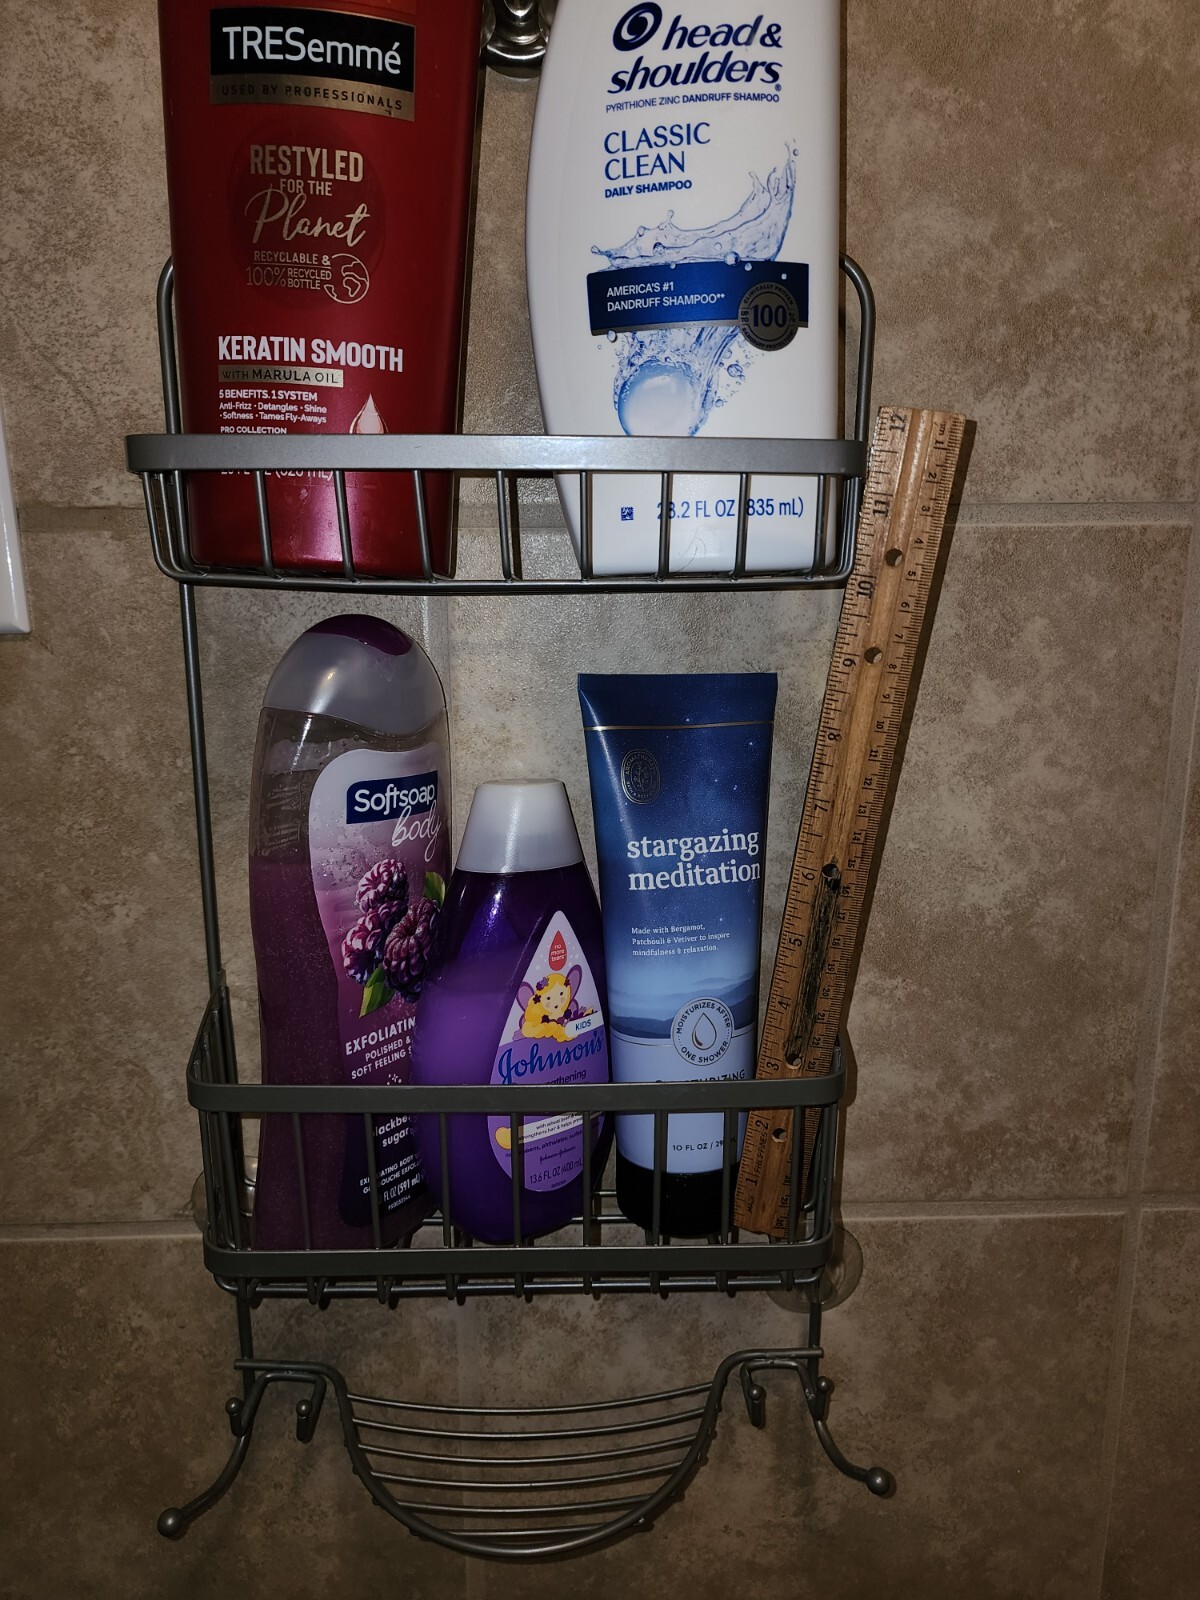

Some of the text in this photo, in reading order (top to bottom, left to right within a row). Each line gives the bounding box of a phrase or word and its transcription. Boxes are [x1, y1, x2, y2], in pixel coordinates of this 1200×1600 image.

[662, 14, 783, 50] head &
[222, 26, 401, 75] TRESemmé
[222, 84, 403, 111] USED BY PROFESSIONALS
[605, 92, 780, 113] PYRITHIONE ZINC DANDRUFF SHAMPOO
[604, 122, 711, 154] CLASSIC
[250, 144, 364, 182] RESTYLED
[604, 151, 685, 181] CLEAN
[280, 179, 333, 196] FOR THE
[604, 179, 693, 198] DAILY SHAMPOO
[245, 184, 371, 248] Planet
[254, 250, 332, 266] RECYCLABLE &
[246, 266, 333, 287] 100% RECYCLED
[287, 278, 321, 290] BOTTLE
[606, 281, 675, 298] AMERICA'S #1
[607, 298, 661, 312] DANDRUFF
[750, 304, 787, 328] 100
[218, 336, 404, 372] KERATIN SMOOTH
[222, 368, 339, 384] WITH MARULA OIL
[219, 389, 318, 401] 5 BENEFITS. 1 SYSTEM
[219, 401, 328, 414] Anti-Frizz Detangles Shine
[222, 411, 327, 425] Softness Tames Fly-Aways
[888, 414, 907, 433] 12
[220, 426, 288, 435] PRO COLLECTION
[929, 471, 938, 480] 2
[695, 500, 711, 518] FL
[715, 499, 736, 518] OZ
[746, 498, 775, 517] 835
[779, 496, 804, 518] mL)
[872, 499, 890, 517] 11
[914, 536, 923, 545] 4
[907, 569, 917, 578] 5
[856, 580, 875, 600] 10
[900, 601, 910, 609] 6
[894, 632, 904, 640] 7
[888, 662, 897, 671] 8
[875, 719, 885, 730] 10
[827, 732, 842, 742] 8
[869, 749, 879, 759] 11
[863, 776, 873, 787] 12
[354, 783, 436, 815] Softsoap
[813, 803, 829, 813] 7
[857, 804, 868, 815] 13
[391, 799, 442, 863] body
[851, 831, 862, 842] 14
[627, 828, 760, 861] stargazing
[847, 857, 857, 868] 15
[628, 858, 761, 891] meditation
[841, 885, 851, 896] 16
[631, 923, 706, 935] Made with Bergamot,
[632, 931, 731, 946] Patchouli & Vetiver to inspire
[788, 937, 803, 947] 5
[831, 937, 842, 948] 18
[632, 947, 676, 957] mindfulness
[683, 944, 719, 954] relaxation.
[827, 963, 836, 973] 19
[822, 987, 832, 998] 20
[777, 1000, 791, 1011] 4
[677, 1001, 731, 1034] MOISTURIZES AFTER
[816, 1012, 826, 1022] 21
[574, 1018, 592, 1032] KIDS
[345, 1016, 416, 1056] EXFOLIATIN
[811, 1036, 822, 1047] 22
[365, 1038, 404, 1062] POLISHED
[405, 1035, 411, 1045] &
[681, 1040, 729, 1063] ONE SHOWER
[351, 1063, 373, 1080] SOFT
[374, 1049, 407, 1070] FEELING
[497, 1030, 605, 1085] Johnson's
[766, 1060, 780, 1072] 3
[807, 1060, 817, 1071] 23
[374, 1115, 411, 1137] lackbe
[755, 1119, 769, 1131] 2
[382, 1127, 410, 1148] sugar
[672, 1144, 683, 1152] 10
[686, 1143, 694, 1151] FL
[697, 1142, 708, 1151] OZ
[359, 1163, 399, 1187] EXATING
[399, 1154, 414, 1168] BODY
[530, 1172, 543, 1184] 13.6
[543, 1170, 552, 1180] FL
[552, 1165, 562, 1177] OZ
[574, 1157, 583, 1168] mL
[379, 1170, 401, 1187] OUCHE
[745, 1177, 759, 1187] 1
[397, 1178, 411, 1196] (591
